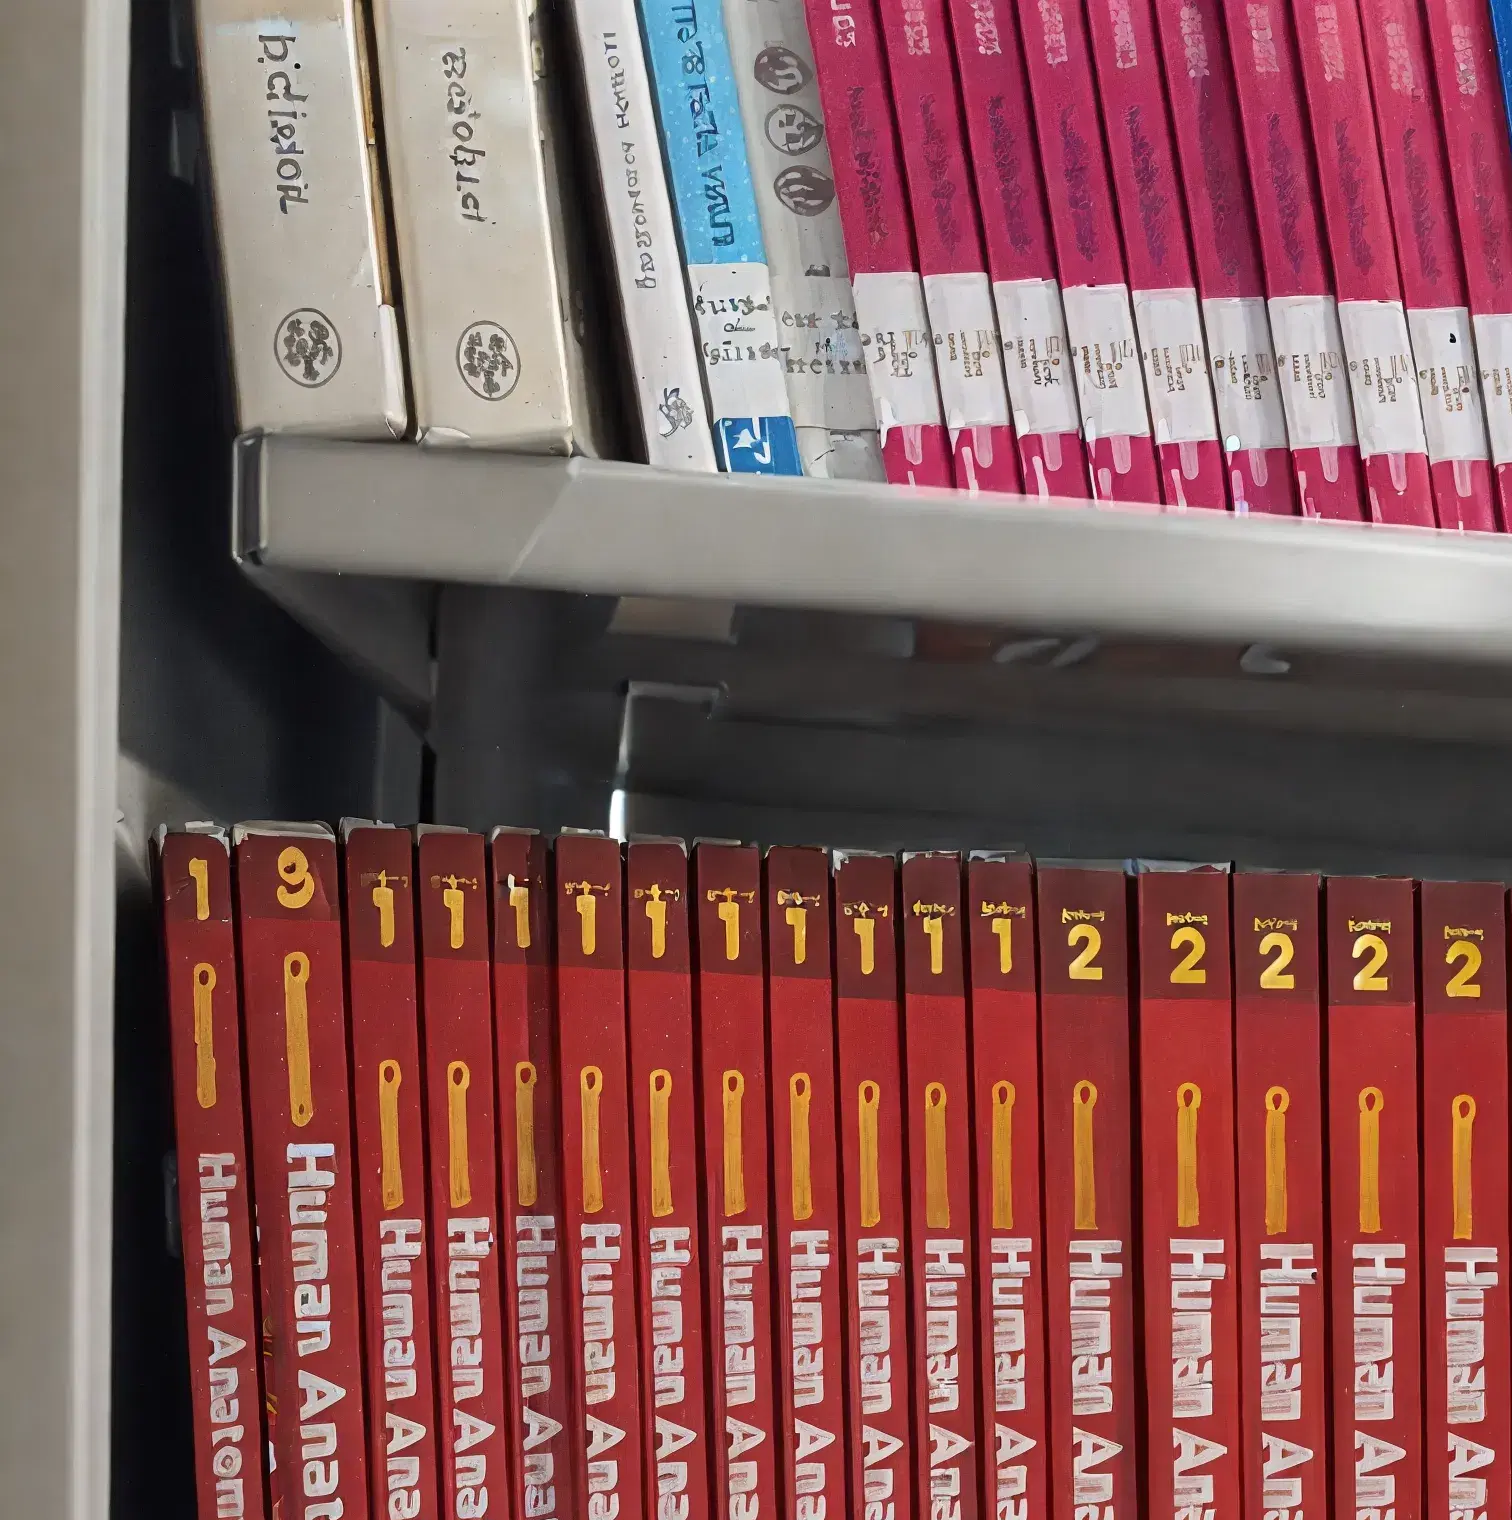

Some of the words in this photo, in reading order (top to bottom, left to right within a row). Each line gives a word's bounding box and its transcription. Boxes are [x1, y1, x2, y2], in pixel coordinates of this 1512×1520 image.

[189, 859, 209, 920] 1
[373, 887, 394, 947] 1
[444, 889, 463, 949] 1
[510, 885, 530, 948] 1
[576, 895, 596, 955] 1
[646, 900, 665, 958] 1
[718, 902, 739, 960] 1
[786, 907, 806, 964] 1
[854, 918, 875, 975] 1
[925, 917, 943, 975] 1
[992, 918, 1012, 974] 1
[1068, 924, 1103, 980] 2
[1171, 927, 1206, 984] 2
[1259, 932, 1295, 989] 2
[1352, 934, 1388, 991] 2
[1445, 940, 1482, 997] 2
[198, 1152, 240, 1316] Human
[285, 1143, 339, 1358] Human
[380, 1218, 428, 1401] Human
[447, 1216, 497, 1404] Human
[516, 1215, 556, 1398] Human
[580, 1222, 624, 1406] Human
[649, 1225, 693, 1409] Human
[720, 1225, 768, 1408] Human
[790, 1230, 831, 1409] Human
[858, 1238, 902, 1412] Human
[924, 1239, 966, 1413] Human
[991, 1236, 1032, 1412] Human
[1068, 1236, 1123, 1415] Human
[1169, 1237, 1226, 1419] Human
[1260, 1242, 1320, 1422] Human
[1352, 1243, 1407, 1422] Human
[1443, 1246, 1500, 1424] Human
